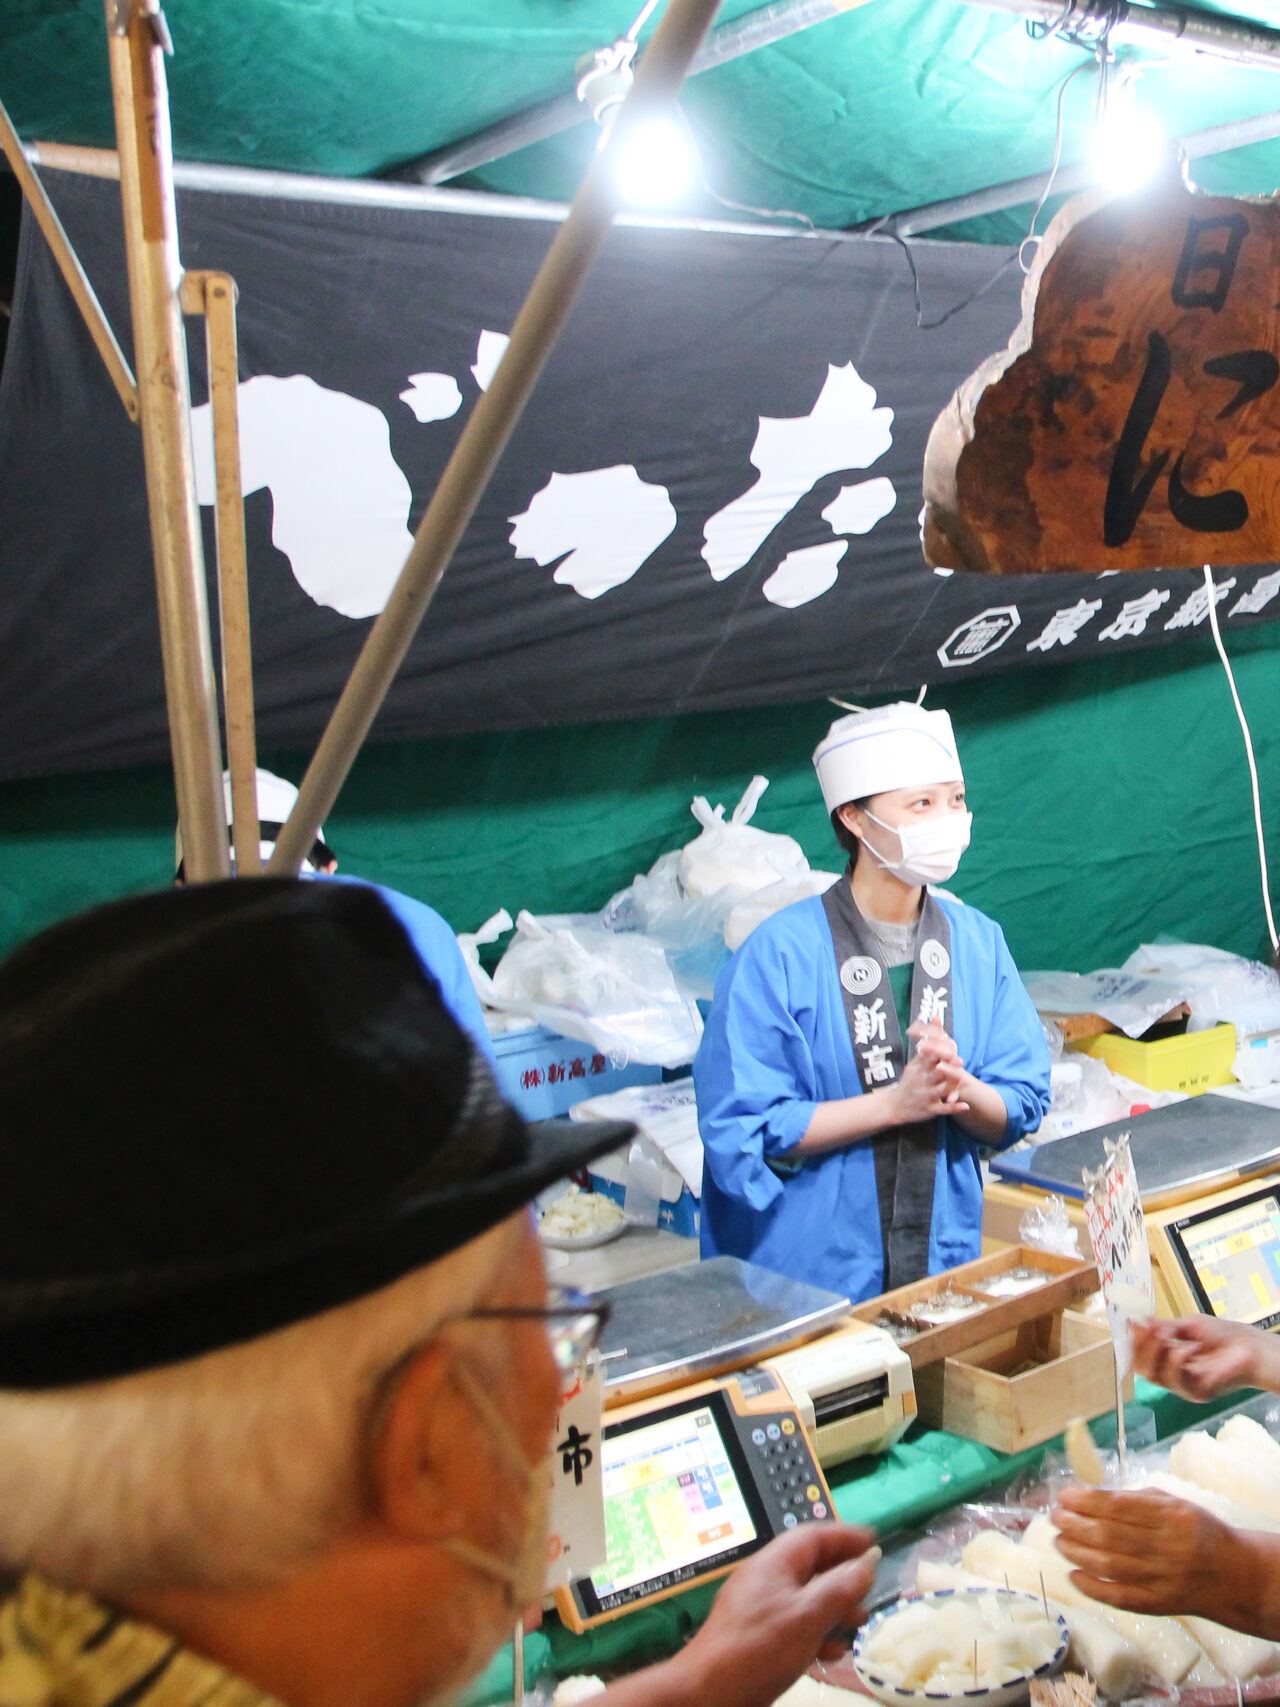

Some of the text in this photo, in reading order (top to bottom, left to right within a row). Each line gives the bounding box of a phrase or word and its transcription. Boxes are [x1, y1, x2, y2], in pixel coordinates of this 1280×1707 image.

[190, 331, 898, 620] べった
[853, 997, 897, 1089] 新高
